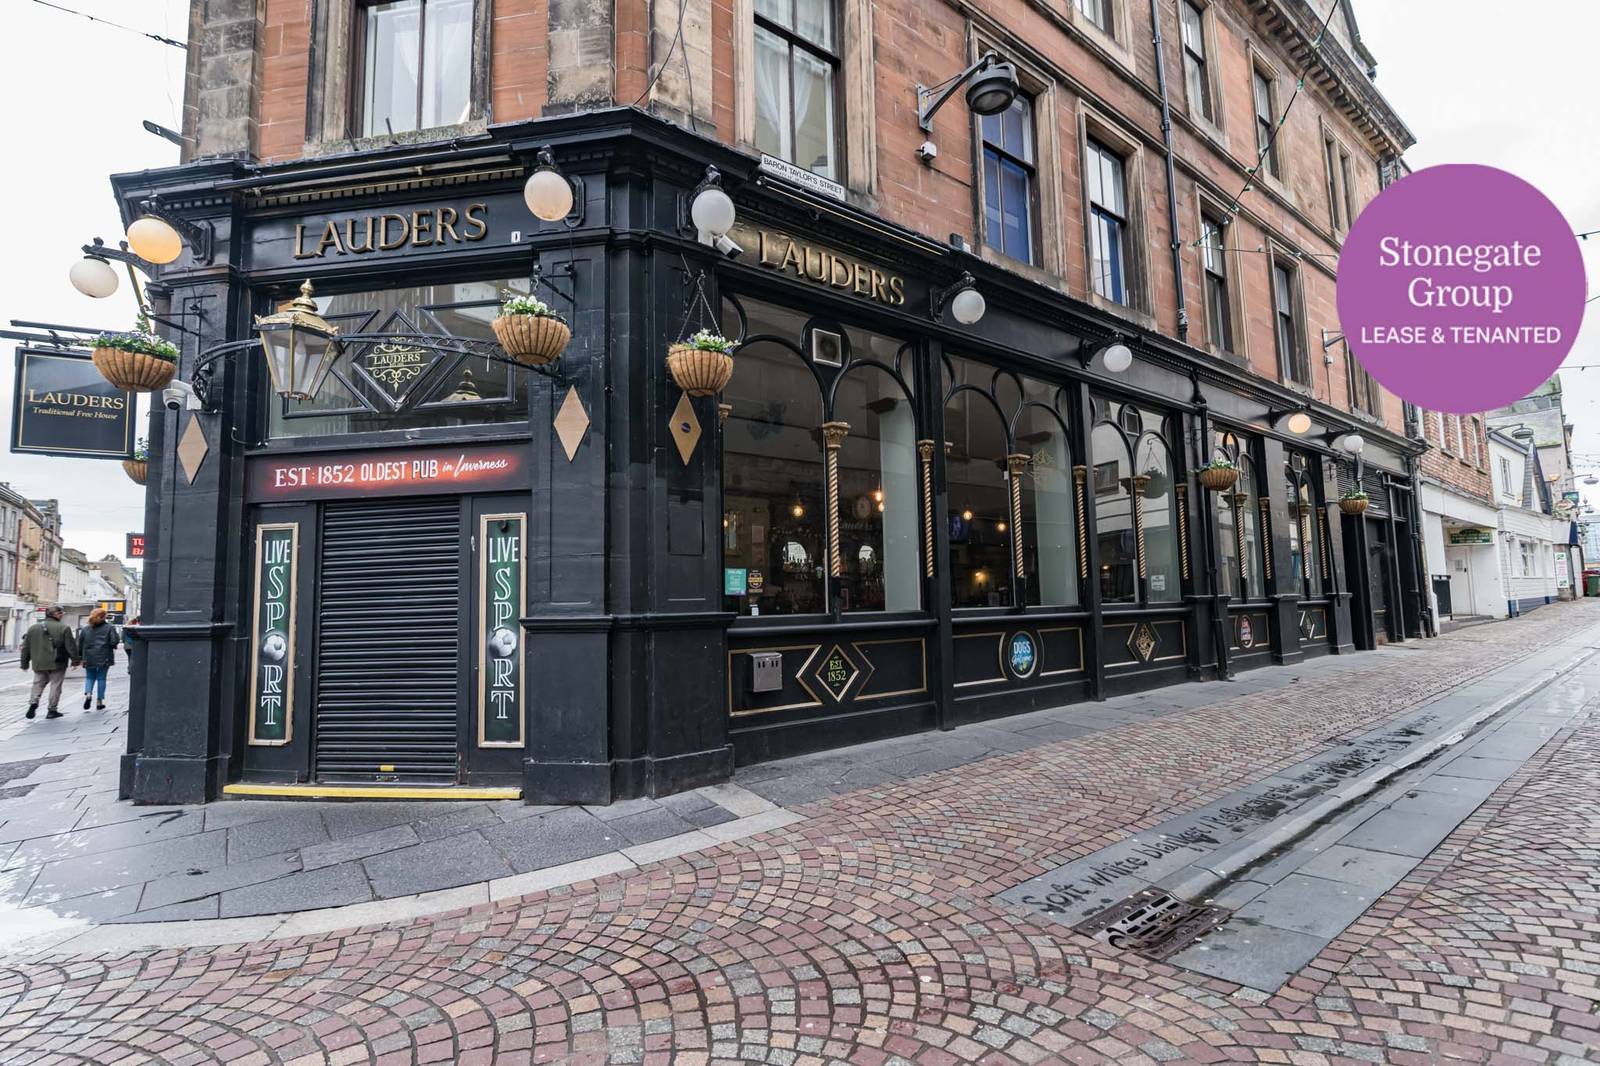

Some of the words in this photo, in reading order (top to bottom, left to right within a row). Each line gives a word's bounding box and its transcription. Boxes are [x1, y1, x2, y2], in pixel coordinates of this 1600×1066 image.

[763, 157, 788, 172] BARON
[819, 179, 843, 195] STREET
[293, 203, 488, 260] LAUDERS
[758, 230, 905, 305] LAUDERS
[373, 352, 422, 365] LAUDERS
[28, 388, 124, 410] LAUDERS
[33, 406, 76, 417] Traditional
[76, 410, 94, 418] Free
[94, 411, 118, 420] House
[360, 461, 408, 482] OLDEST
[411, 459, 439, 479] PUB
[442, 461, 454, 473] in
[453, 454, 509, 478] Inverness
[264, 539, 291, 564] LIVE
[488, 536, 520, 563] LIVE
[1013, 641, 1031, 654] DOGS
[828, 670, 847, 682] 1852
[1022, 882, 1090, 914] Soft
[1080, 856, 1149, 888] white
